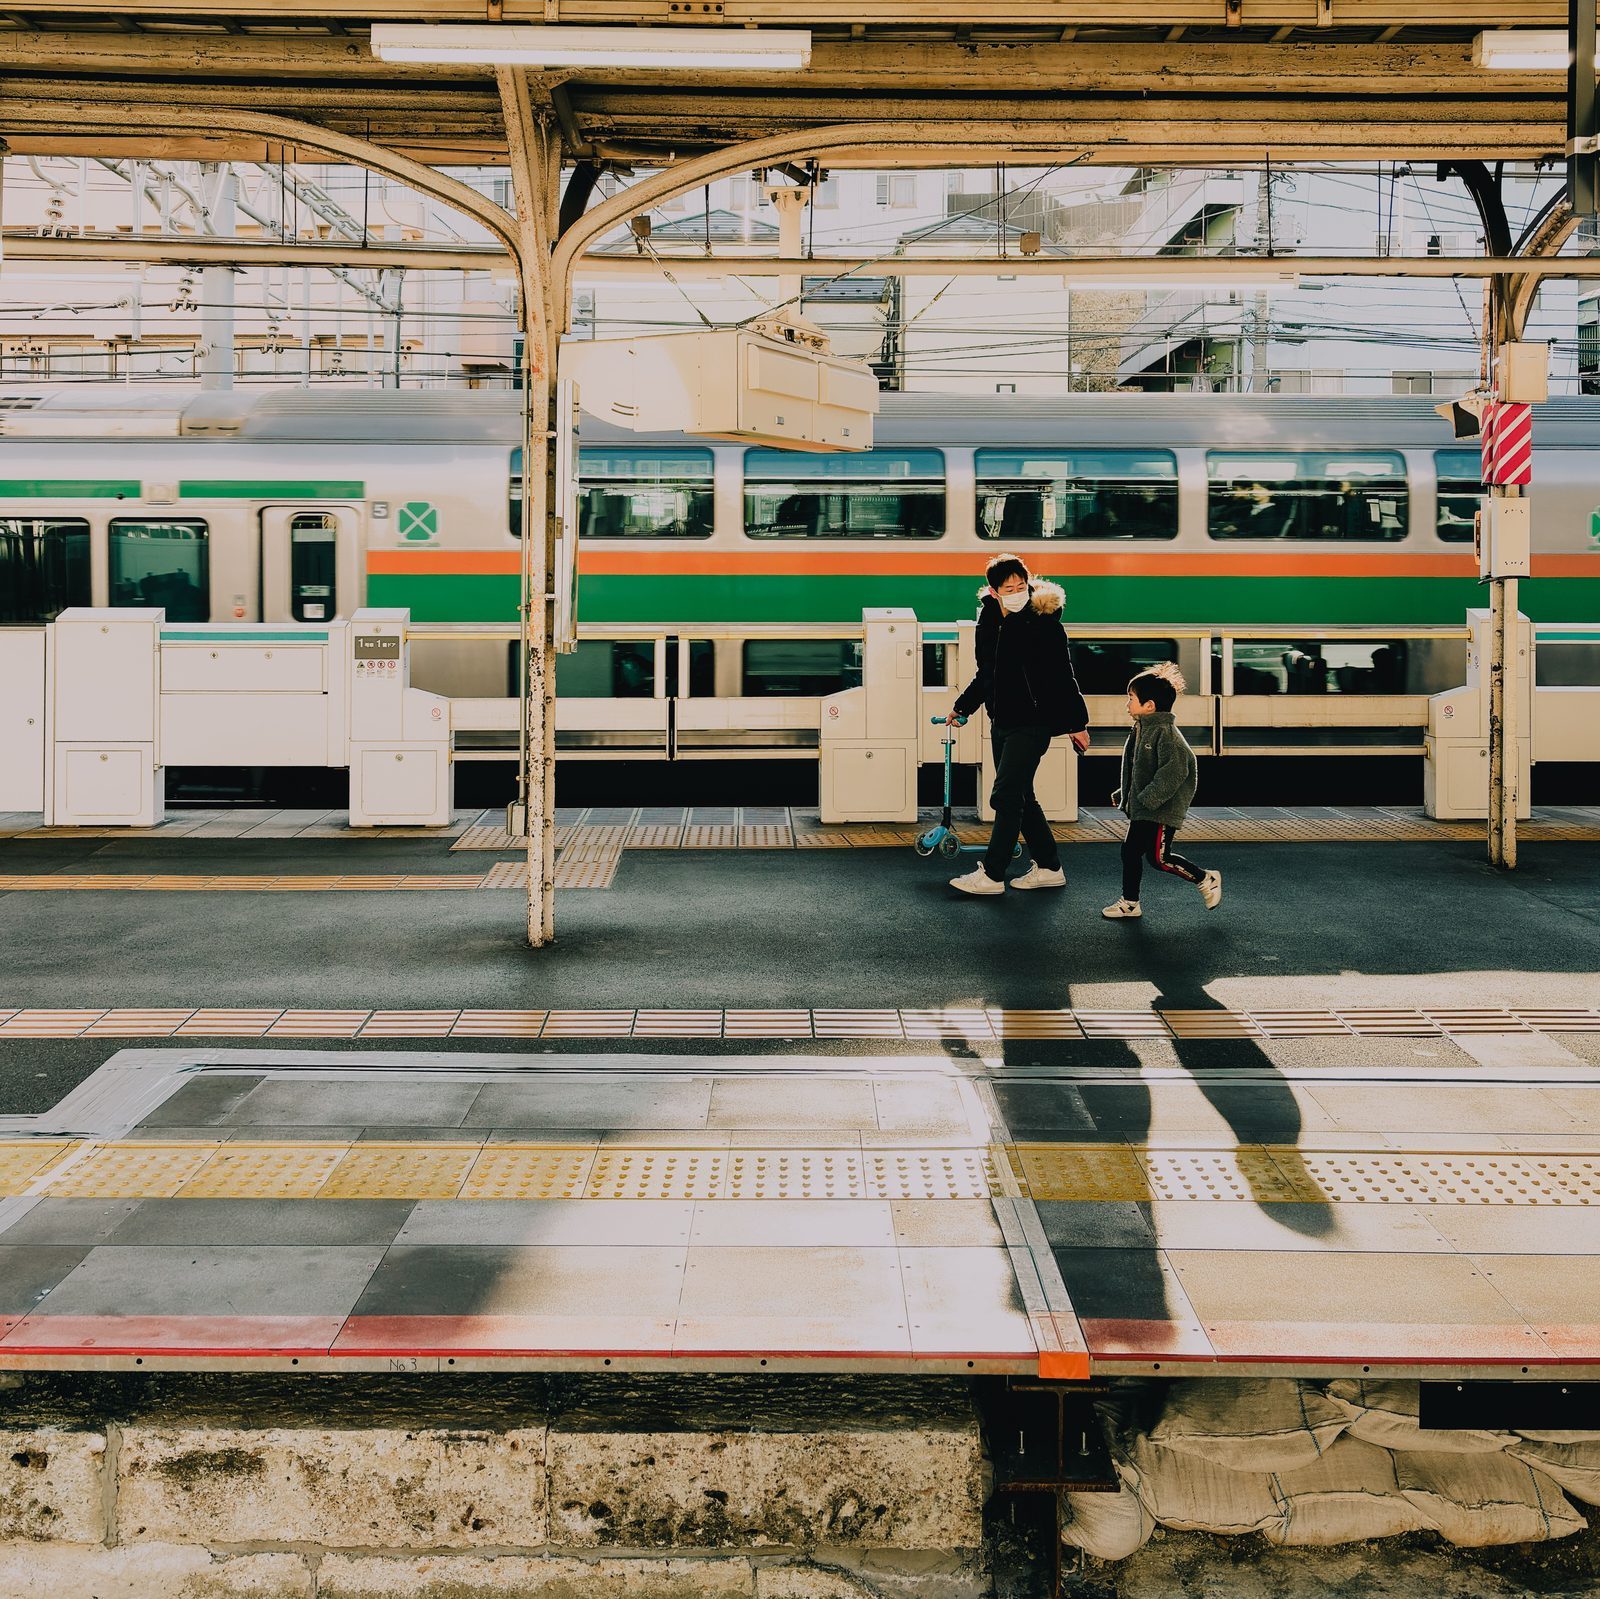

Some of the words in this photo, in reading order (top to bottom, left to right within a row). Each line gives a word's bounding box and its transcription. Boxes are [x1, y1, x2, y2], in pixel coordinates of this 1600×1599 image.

[373, 504, 388, 517] 5
[389, 1359, 405, 1371] No
[410, 1358, 417, 1371] 3
